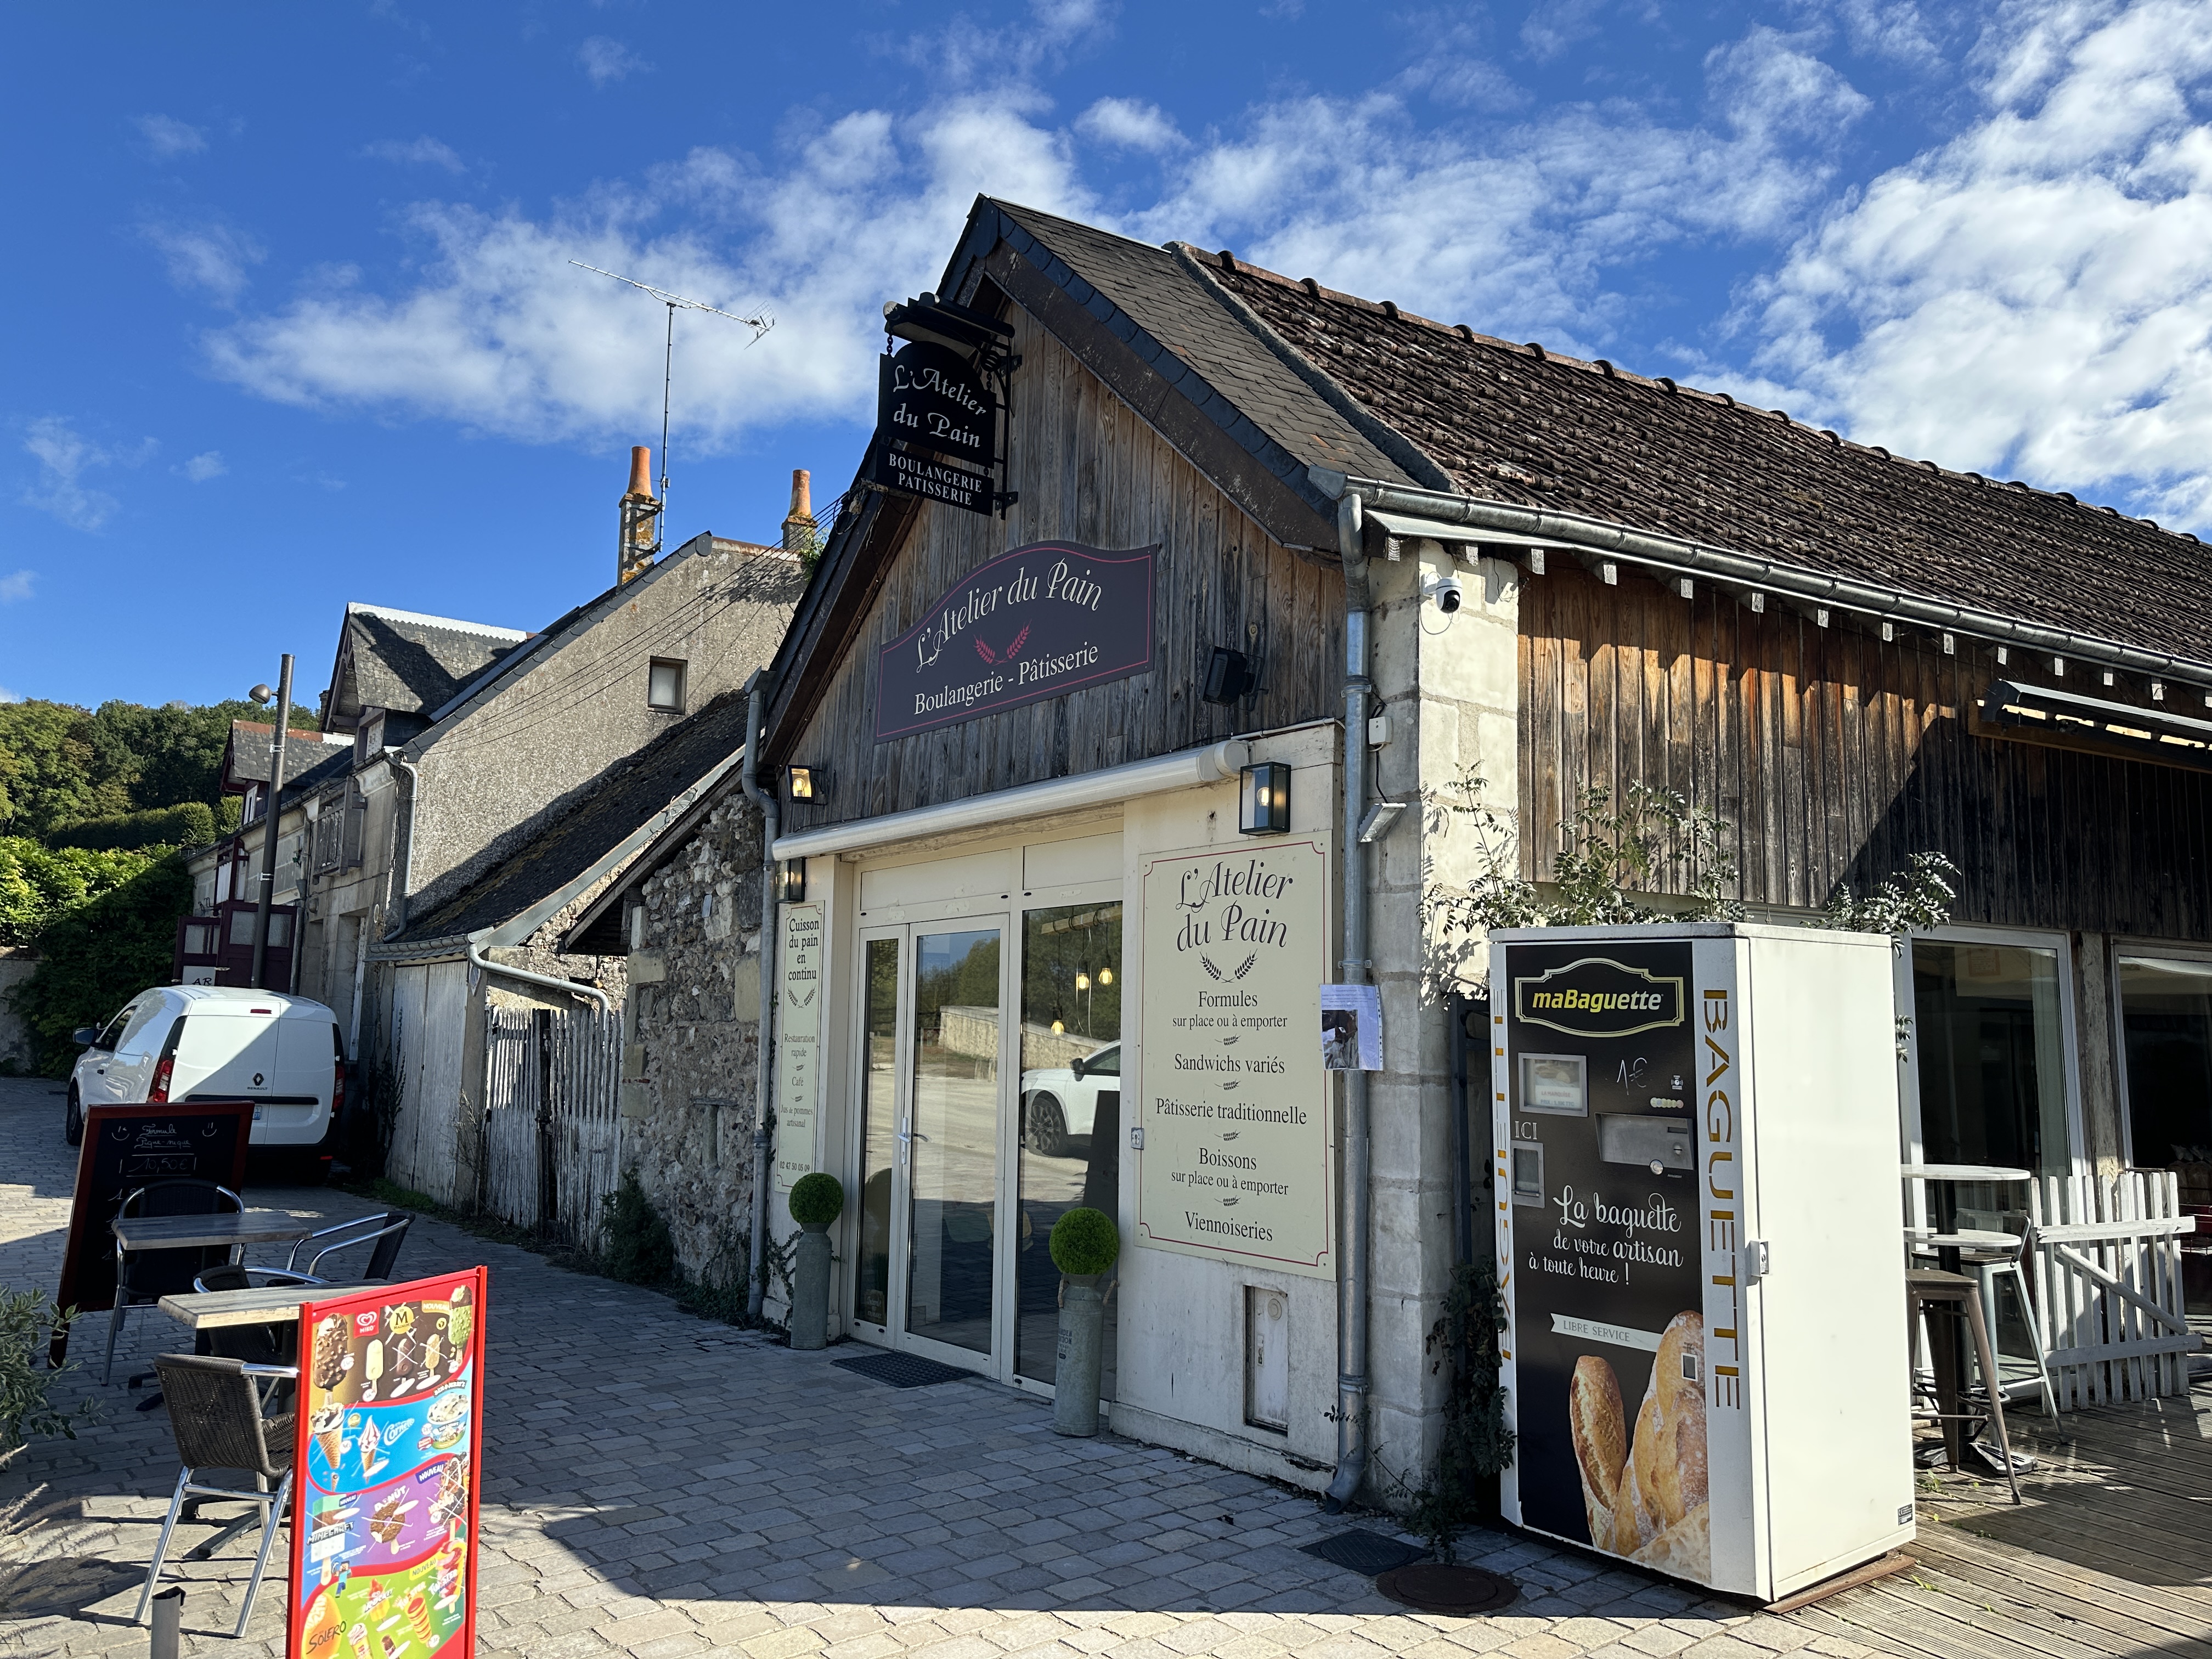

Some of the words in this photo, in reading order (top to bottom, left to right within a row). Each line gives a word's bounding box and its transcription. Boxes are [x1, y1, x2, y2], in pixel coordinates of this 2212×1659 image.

[893, 365, 986, 416] L'Atelier
[894, 403, 919, 428] du
[927, 412, 980, 448] Pain
[889, 453, 982, 493] BOULANGERIE
[898, 472, 972, 505] PATISSERIE
[916, 585, 1003, 673] L'Atelier
[1007, 566, 1039, 605] du
[1046, 557, 1103, 611] Pain
[914, 670, 1004, 715] Boulangerie
[1018, 641, 1098, 686] Pâtisserie
[1175, 859, 1293, 913] L'Atelier
[789, 918, 820, 933] Cuisson
[1177, 913, 1211, 952] du
[1221, 900, 1287, 947] Pain
[789, 935, 799, 949] du
[801, 934, 819, 951] pain
[797, 953, 806, 964] en
[788, 967, 817, 980] continu
[1198, 990, 1258, 1007] Formules
[1532, 989, 1662, 1013] maBaguette
[1172, 1016, 1187, 1028] sur
[1189, 1014, 1214, 1031] place
[1217, 1016, 1229, 1027] ou
[1232, 1013, 1238, 1027] à
[1240, 1015, 1288, 1031] emporter
[784, 1033, 815, 1043] Restauration
[791, 1047, 807, 1059] rapide
[1174, 1053, 1241, 1072] Sandwichs
[1245, 1056, 1285, 1074] variés
[792, 1076, 804, 1086] Café
[787, 1119, 805, 1127] artisanal
[794, 1107, 813, 1116] pommes
[1156, 1098, 1214, 1118] Pâtisserie
[1217, 1103, 1307, 1125] traditionnelle
[139, 1124, 177, 1137] Formule
[1514, 1120, 1538, 1140] ICI
[134, 1137, 191, 1149] Pique-nique
[780, 1161, 785, 1169] 02
[792, 1163, 797, 1171] 50
[798, 1163, 804, 1171] 05
[804, 1164, 810, 1172] 09
[1199, 1147, 1257, 1170] Boissons
[1171, 1171, 1186, 1182] sur
[1188, 1170, 1214, 1187] place
[1216, 1178, 1229, 1188] ou
[1232, 1175, 1238, 1189] à
[1240, 1181, 1289, 1195] emporter
[1703, 989, 1740, 1410] BAGUETTE
[1553, 1185, 1589, 1228] La
[1593, 1192, 1681, 1238] baguette
[1185, 1211, 1273, 1242] Viennoiseries
[1554, 1228, 1570, 1250] de
[1574, 1237, 1609, 1256] votre
[1613, 1240, 1683, 1267] artisan
[1528, 1252, 1539, 1270] à
[1543, 1256, 1576, 1276] toute
[1579, 1257, 1618, 1283] heure
[1625, 1262, 1629, 1285] !
[1563, 1320, 1589, 1334] LIBRE
[1592, 1322, 1630, 1342] SERVICE
[384, 1418, 415, 1446] Cornetto
[419, 1464, 444, 1482] NOUVEAU
[307, 1521, 354, 1545] MINECRAFT
[412, 1558, 436, 1576] NOUVEAU
[306, 1620, 347, 1655] SOLERO
